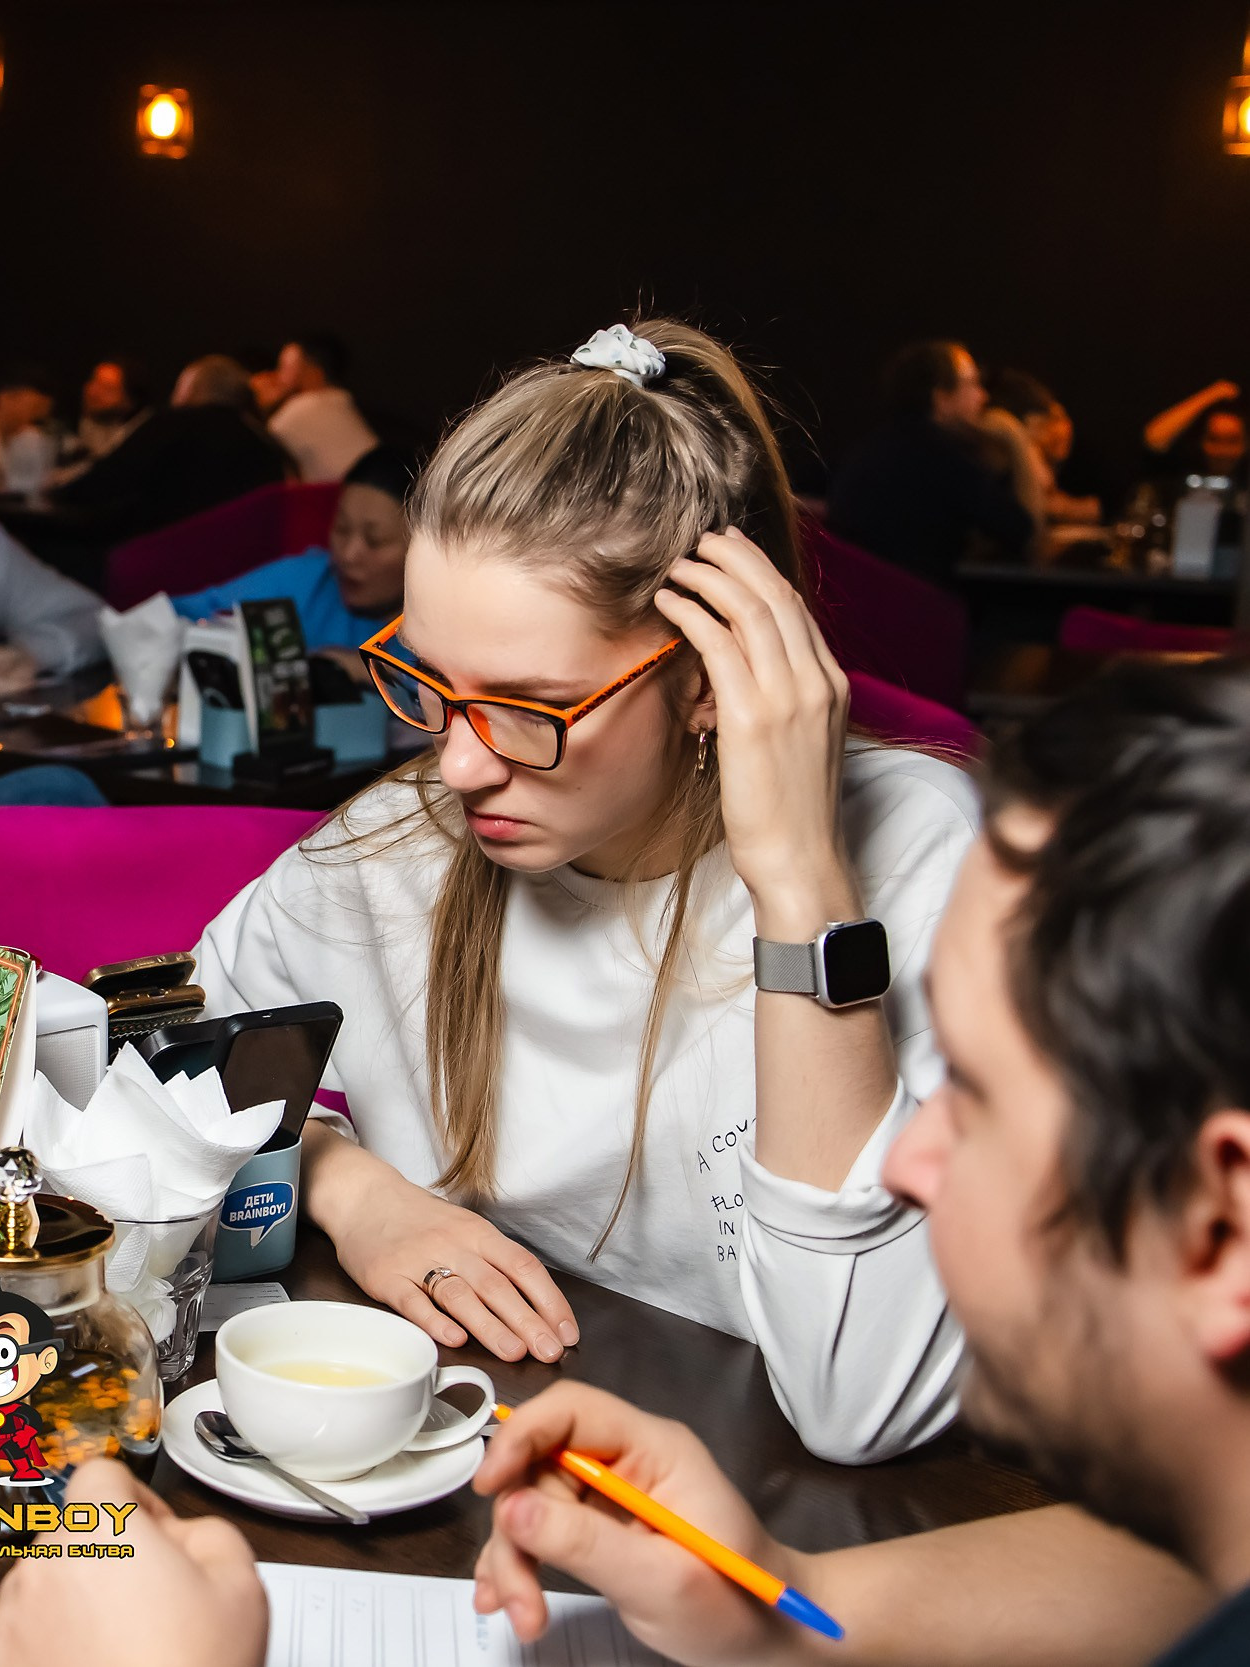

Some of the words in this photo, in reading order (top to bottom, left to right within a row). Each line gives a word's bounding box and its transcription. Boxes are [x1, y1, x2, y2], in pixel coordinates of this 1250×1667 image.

[697, 1150, 711, 1174] A
[244, 1192, 274, 1209] ДЕТИ
[229, 1202, 286, 1222] BRAINBOY!
[718, 1220, 735, 1236] IN
